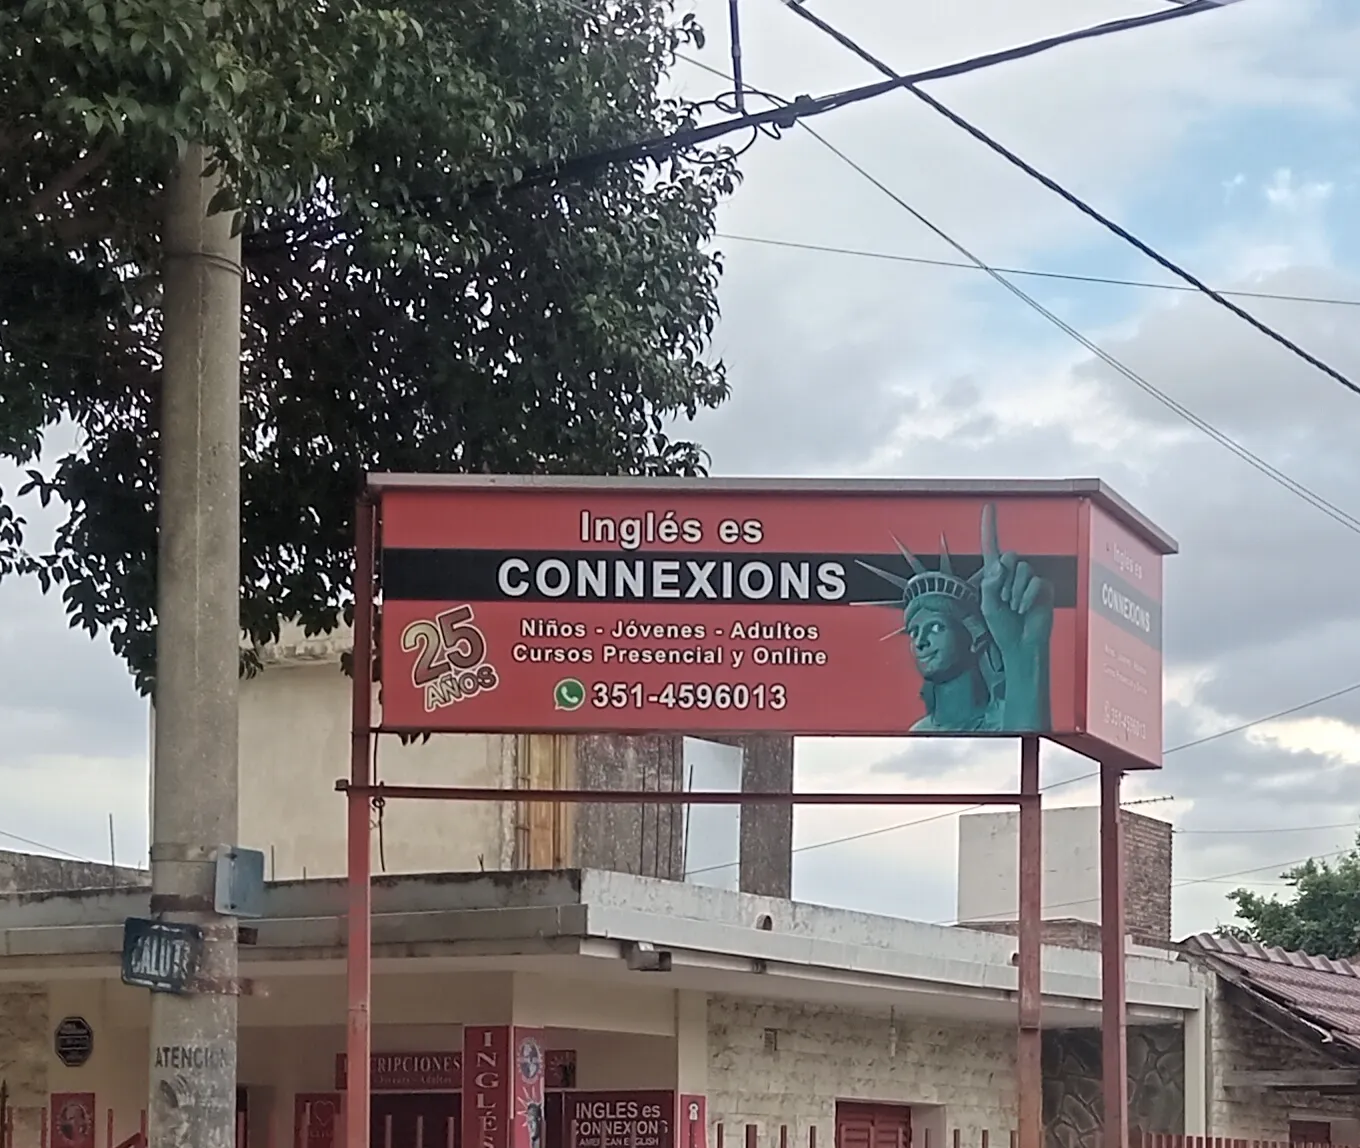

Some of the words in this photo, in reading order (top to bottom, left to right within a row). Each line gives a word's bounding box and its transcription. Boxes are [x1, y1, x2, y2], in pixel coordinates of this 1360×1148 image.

[580, 511, 702, 549] Inglés
[718, 519, 764, 543] es
[497, 558, 847, 600] CONNEXIONS
[521, 619, 587, 638] Niños
[611, 620, 705, 639] Jóvenes
[730, 622, 819, 640] Adultos
[401, 604, 487, 688] 25
[512, 645, 593, 663] Cursos
[603, 646, 723, 664] Presencial
[732, 649, 744, 667] y
[753, 647, 827, 665] Online
[425, 664, 499, 712] AÑOS
[592, 682, 788, 710] 351-4596013
[575, 1101, 638, 1119] INGLES
[642, 1104, 661, 1118] es
[575, 1120, 668, 1136] ONNEXON
[623, 1137, 659, 1147] EGLISH
